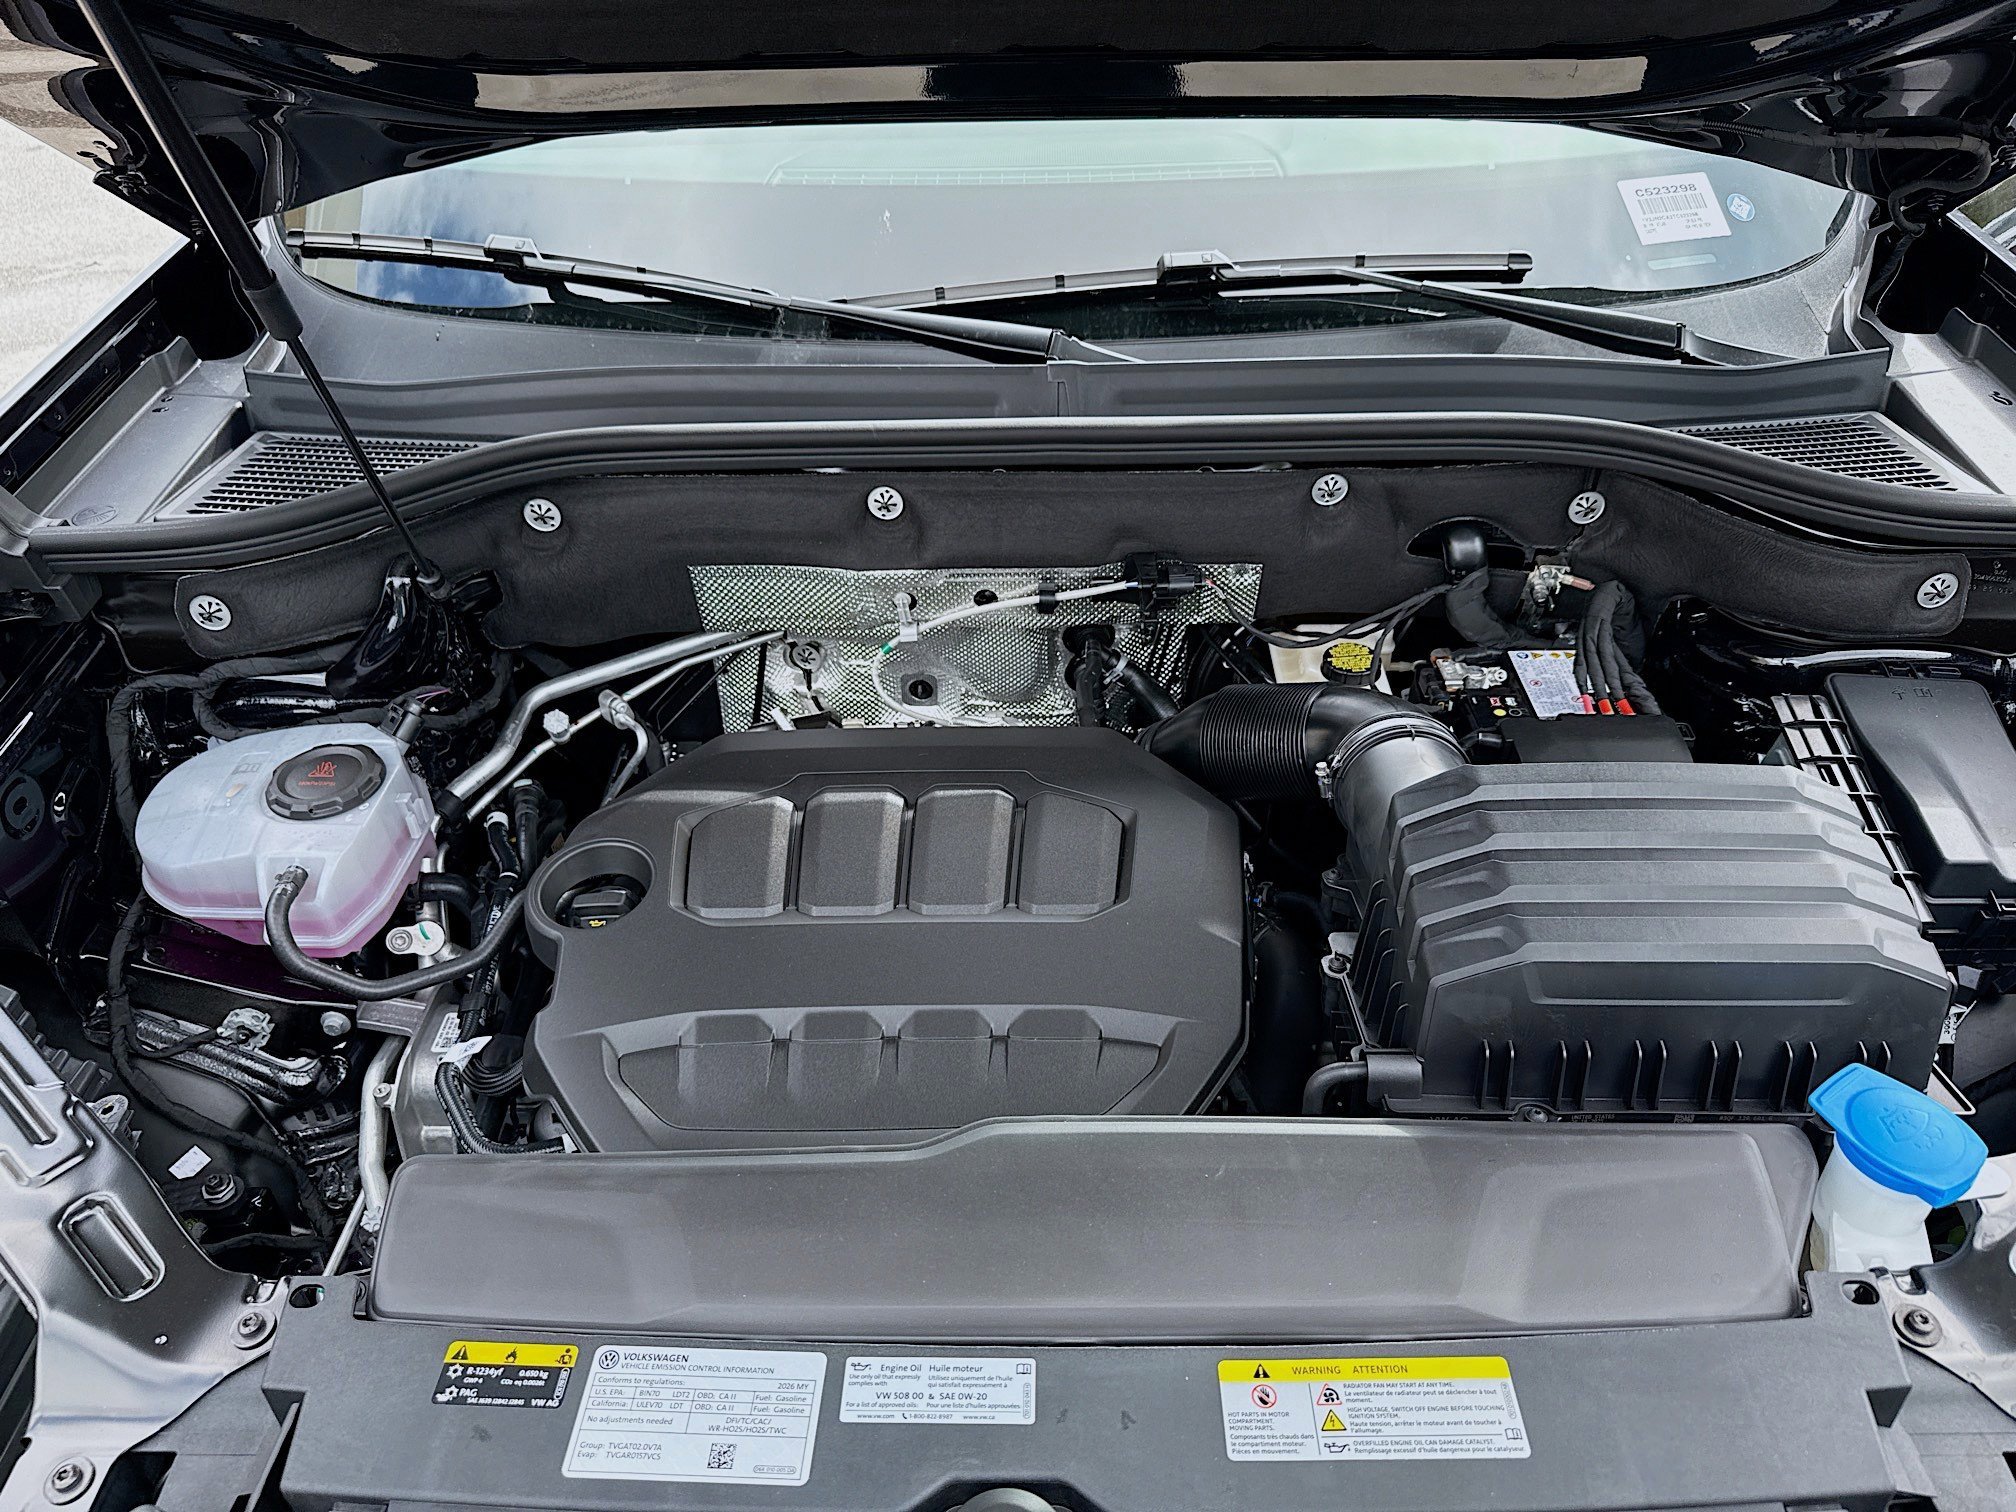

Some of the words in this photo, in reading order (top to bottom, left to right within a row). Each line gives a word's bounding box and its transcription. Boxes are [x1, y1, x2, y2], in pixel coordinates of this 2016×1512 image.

[1635, 183, 1697, 198] C523298
[623, 1352, 690, 1362] VOLKSWAGEN
[621, 1362, 650, 1370] VEHICLE
[651, 1363, 686, 1371] EMISSION
[688, 1364, 721, 1373] CONTROL
[723, 1366, 775, 1374] INFORMATION
[881, 1364, 908, 1373] Engine
[910, 1364, 922, 1372] Oil
[1291, 1366, 1341, 1375] WARNING
[1353, 1365, 1408, 1374] ATTENTION
[466, 1367, 504, 1378] R-1234yf
[539, 1370, 550, 1380] kg
[598, 1376, 632, 1384] Conforms
[643, 1378, 685, 1386] regulations:
[777, 1382, 795, 1390] 2026
[459, 1388, 478, 1397] PAG
[672, 1391, 691, 1399] LDT2
[697, 1392, 716, 1400] OBD:
[775, 1395, 807, 1403] Gasoline
[875, 1392, 892, 1400] VW
[893, 1392, 910, 1400] 508
[911, 1392, 924, 1400] 00
[939, 1392, 956, 1400] SAE
[958, 1392, 988, 1401] 0W-20
[531, 1399, 546, 1407] VW
[591, 1400, 629, 1408] California:
[694, 1403, 713, 1411] OBD:
[773, 1406, 805, 1414] Gasoline
[599, 1416, 644, 1425] adjustments
[580, 1441, 605, 1450] Group:
[577, 1450, 597, 1459] Evap:
